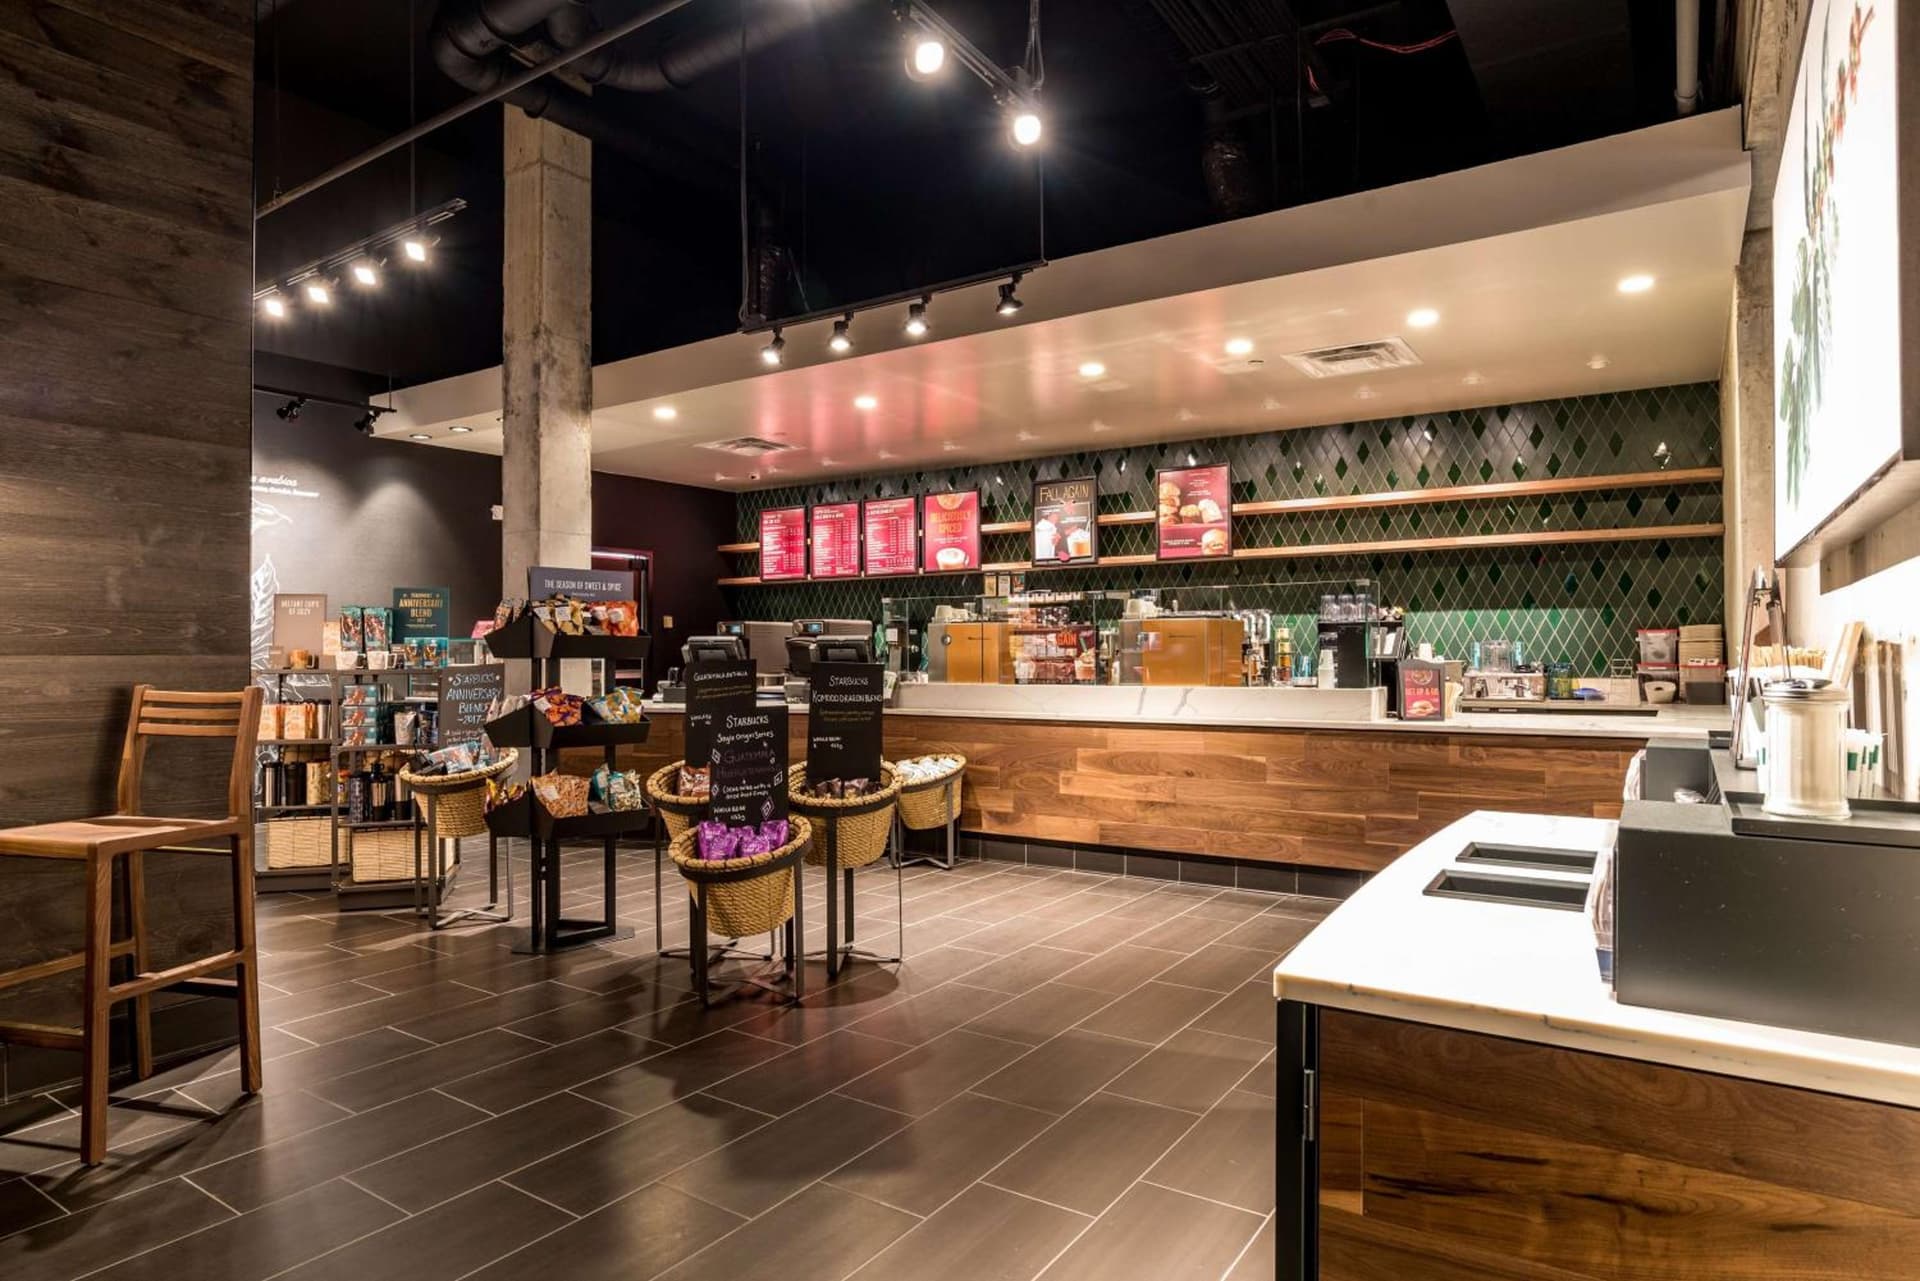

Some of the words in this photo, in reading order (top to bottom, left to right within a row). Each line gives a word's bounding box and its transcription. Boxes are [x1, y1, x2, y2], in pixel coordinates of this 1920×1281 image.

[1063, 484, 1089, 498] AGAIN
[555, 580, 577, 590] SEASON
[577, 581, 584, 590] OF
[584, 581, 601, 591] SWEET
[602, 582, 608, 591] &
[607, 582, 623, 592] SPICE
[399, 599, 444, 609] ANNIVERSARY
[410, 608, 433, 618] BLEND
[828, 675, 870, 687] STARBUCKS
[446, 687, 502, 701] ANNIVERSARY
[458, 702, 489, 714] BLEND
[726, 714, 769, 729] STARBUCKS
